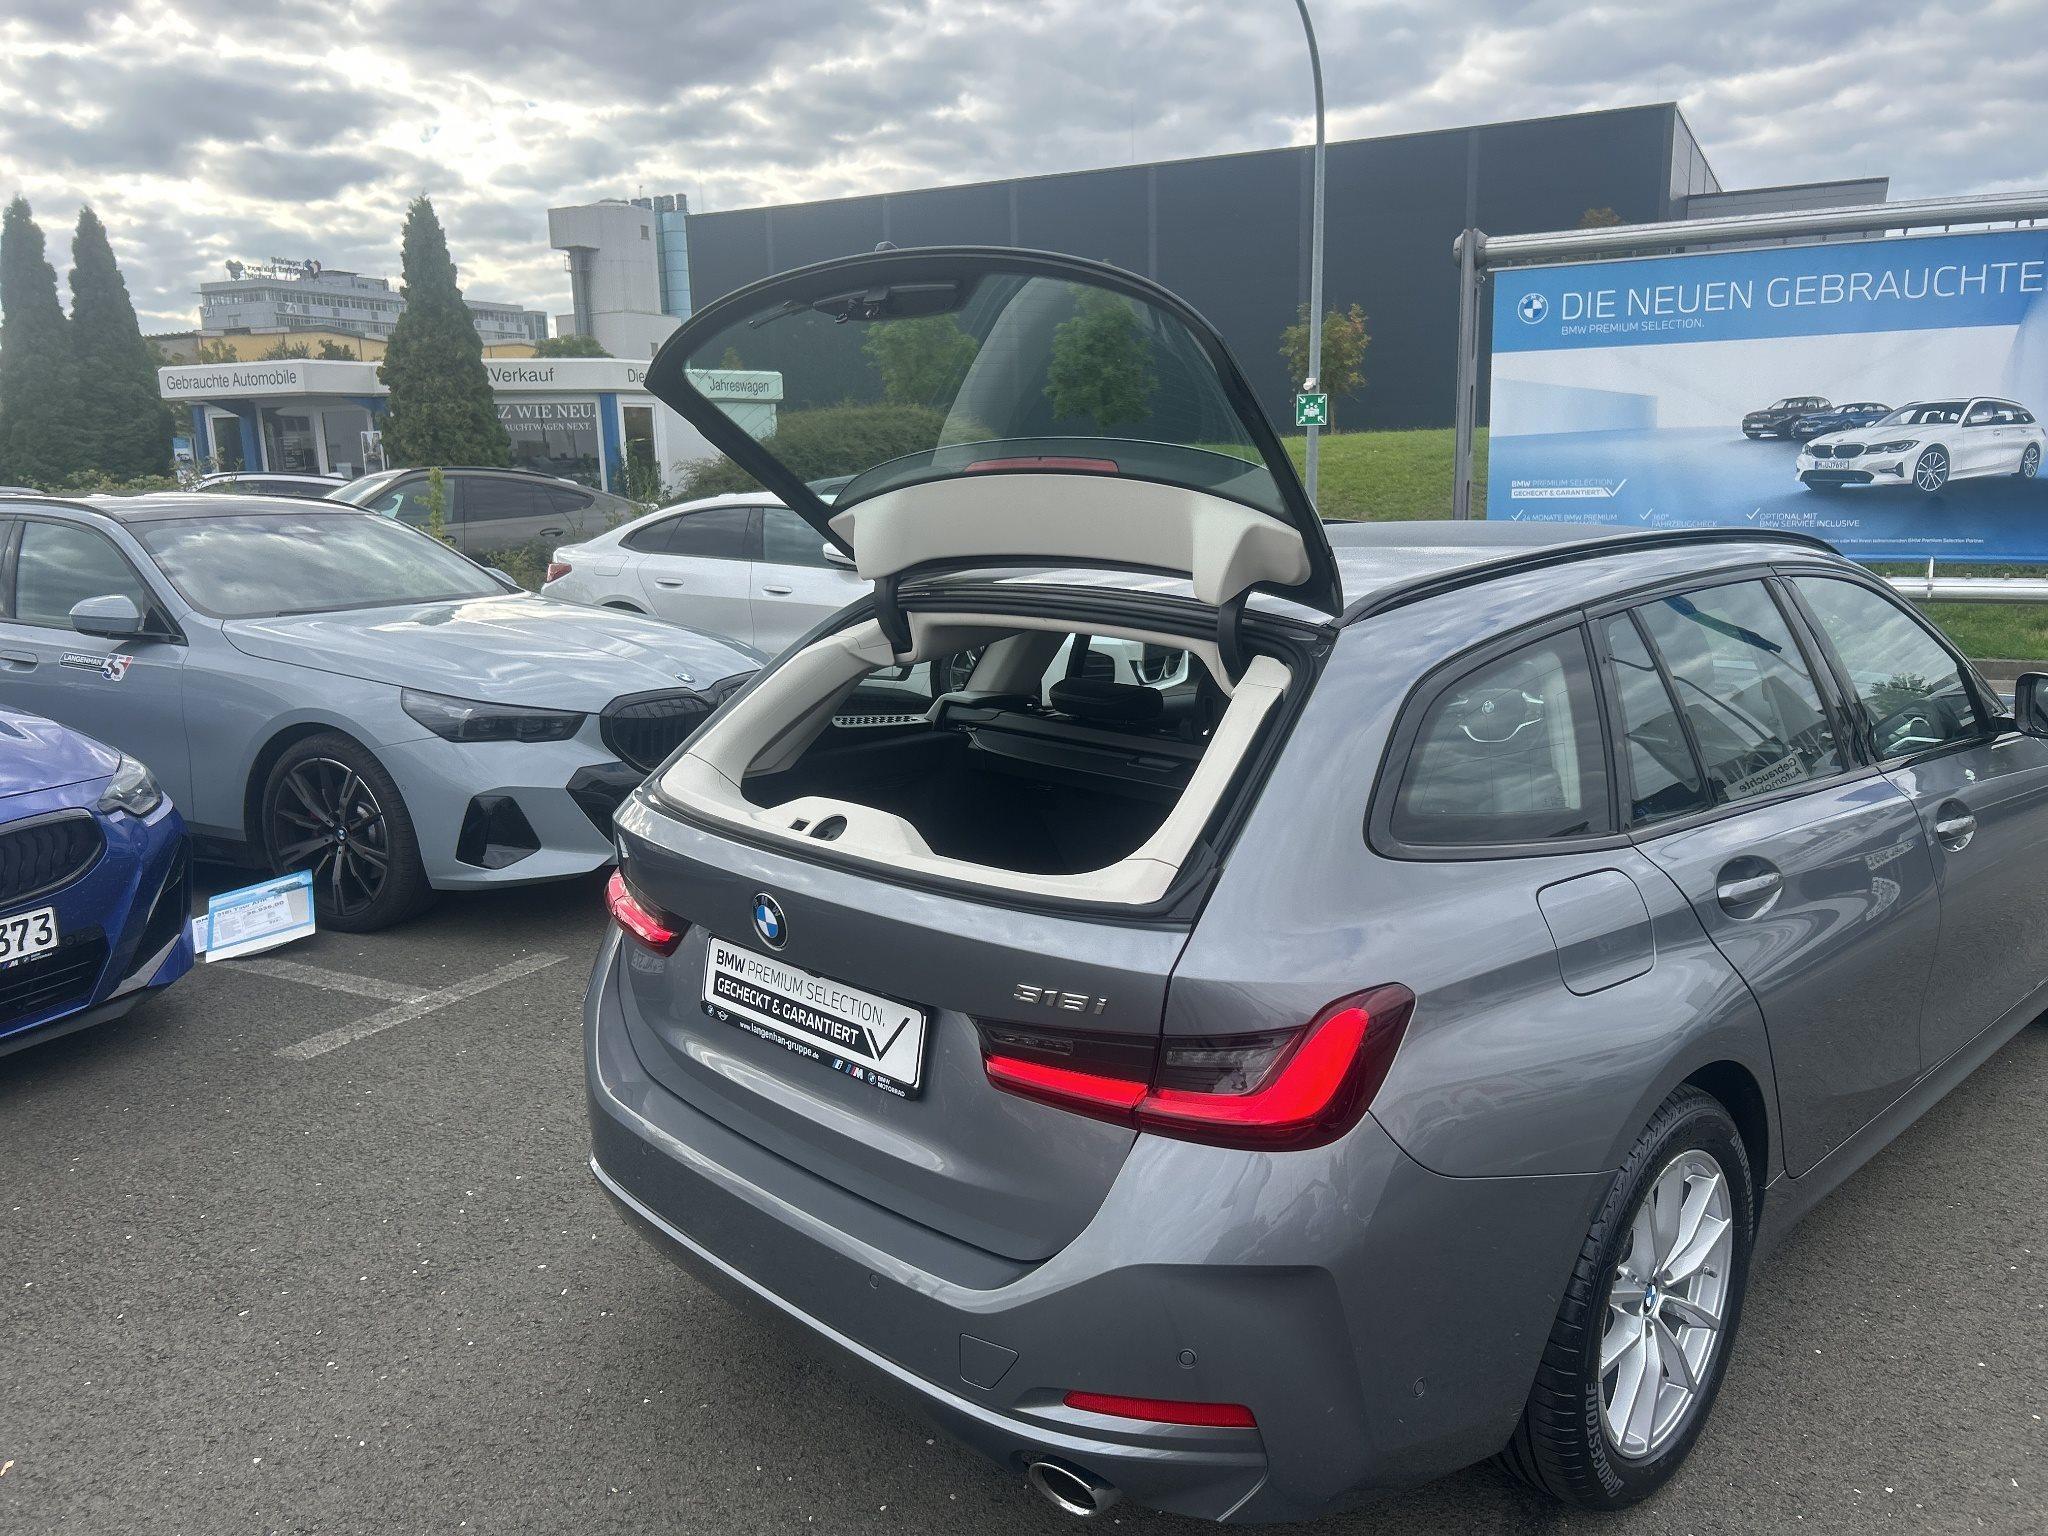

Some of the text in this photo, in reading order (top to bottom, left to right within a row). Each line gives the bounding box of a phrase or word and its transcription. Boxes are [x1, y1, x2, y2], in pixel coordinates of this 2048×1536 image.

[1562, 260, 2048, 321] DIE NEUEN GEBRAUCHTE
[1562, 318, 1705, 336] BMW PREMIUM SELECTION.
[166, 369, 297, 390] Gebrauchte Automobile
[490, 367, 555, 383] Verkauf
[627, 368, 647, 383] Die
[709, 379, 770, 396] Jahreswagen
[498, 403, 596, 419] Z WIE NEU.
[504, 422, 592, 432] AUCHTWAGEN NEXT.
[1511, 480, 1531, 488] BMW
[1532, 479, 1568, 487] PREMIUM
[1513, 489, 1548, 497] GECHECKT
[1549, 489, 1554, 497] &
[1583, 513, 1618, 521] PREMIUM
[1759, 512, 1818, 521] OPTIONAL MIT
[1759, 519, 1860, 528] BMW SERVICE INCLUSIVE
[63, 653, 103, 667] LANGENHAN
[716, 949, 886, 1028] BMW PREMIUM SELECTION.
[1012, 983, 1108, 1014] 318i
[717, 977, 860, 1045] GECHECKT & GARANTIERT
[739, 1021, 820, 1060] www.langenhan-gruppe.de
[877, 1075, 891, 1085] BMW
[877, 1082, 906, 1098] MOTORRAD
[1585, 1382, 1625, 1498] BRIDGESTONE
